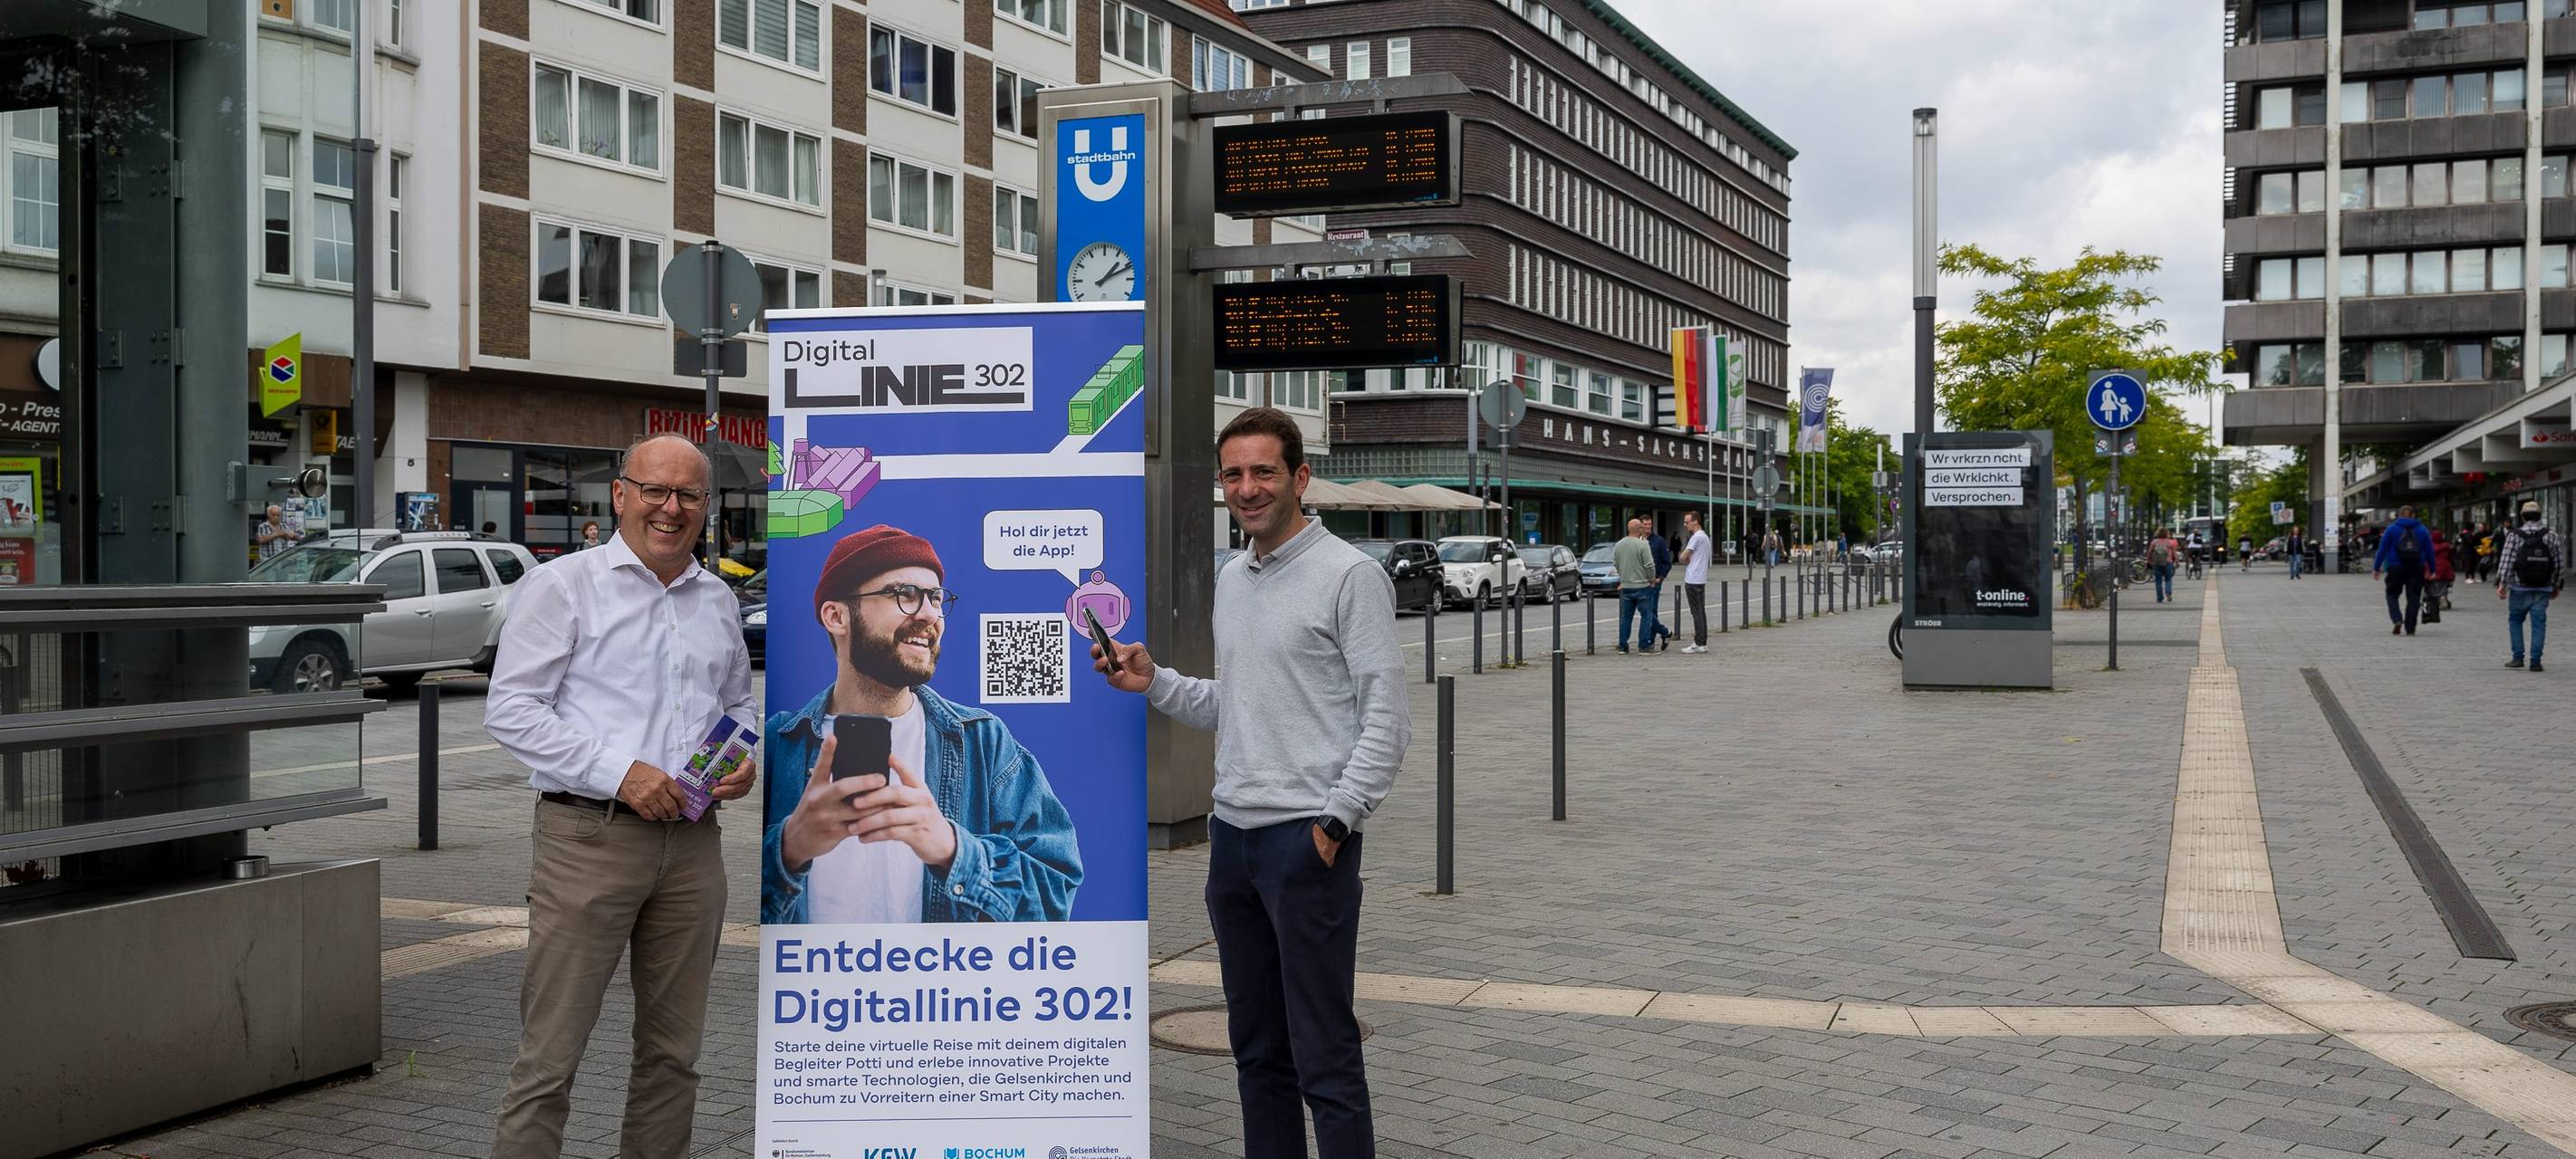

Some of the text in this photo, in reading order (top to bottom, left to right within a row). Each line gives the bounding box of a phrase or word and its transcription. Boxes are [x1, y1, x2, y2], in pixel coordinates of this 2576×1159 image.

[1067, 151, 1136, 165] stadtbahn
[1074, 127, 1128, 202] U
[1327, 231, 1364, 241] Restaurant
[783, 339, 875, 367] Digital
[784, 363, 1025, 408] LINIE 302
[718, 415, 768, 449] ANG
[1543, 417, 1754, 471] HANS-SACHS-HAU
[1931, 453, 2023, 465] Wr vrkrzn ncht
[1931, 472, 2014, 484] die Wrklchkt.
[1931, 491, 2015, 505] Versprochen.
[999, 524, 1089, 540] Hol dir jetzt
[1013, 543, 1075, 559] die App!
[1975, 589, 2030, 601] t-online.
[775, 935, 1077, 973] Entdecke die
[774, 986, 1132, 1032] Digitallinie 302!
[774, 1037, 1127, 1053] Starte deine virtuelle Reise mit deinem digitalen
[774, 1054, 1110, 1073] Begleiter Potti und erlebe innovative Projekte
[774, 1071, 1131, 1088] und smarte Technologien, die Gelsenkirchen und
[774, 1088, 1125, 1105] Bochum zu Vorreitern einer Smart City machen.
[964, 1147, 1025, 1159] BOCHUM
[1070, 1145, 1119, 1154] Gelsenkirchen
